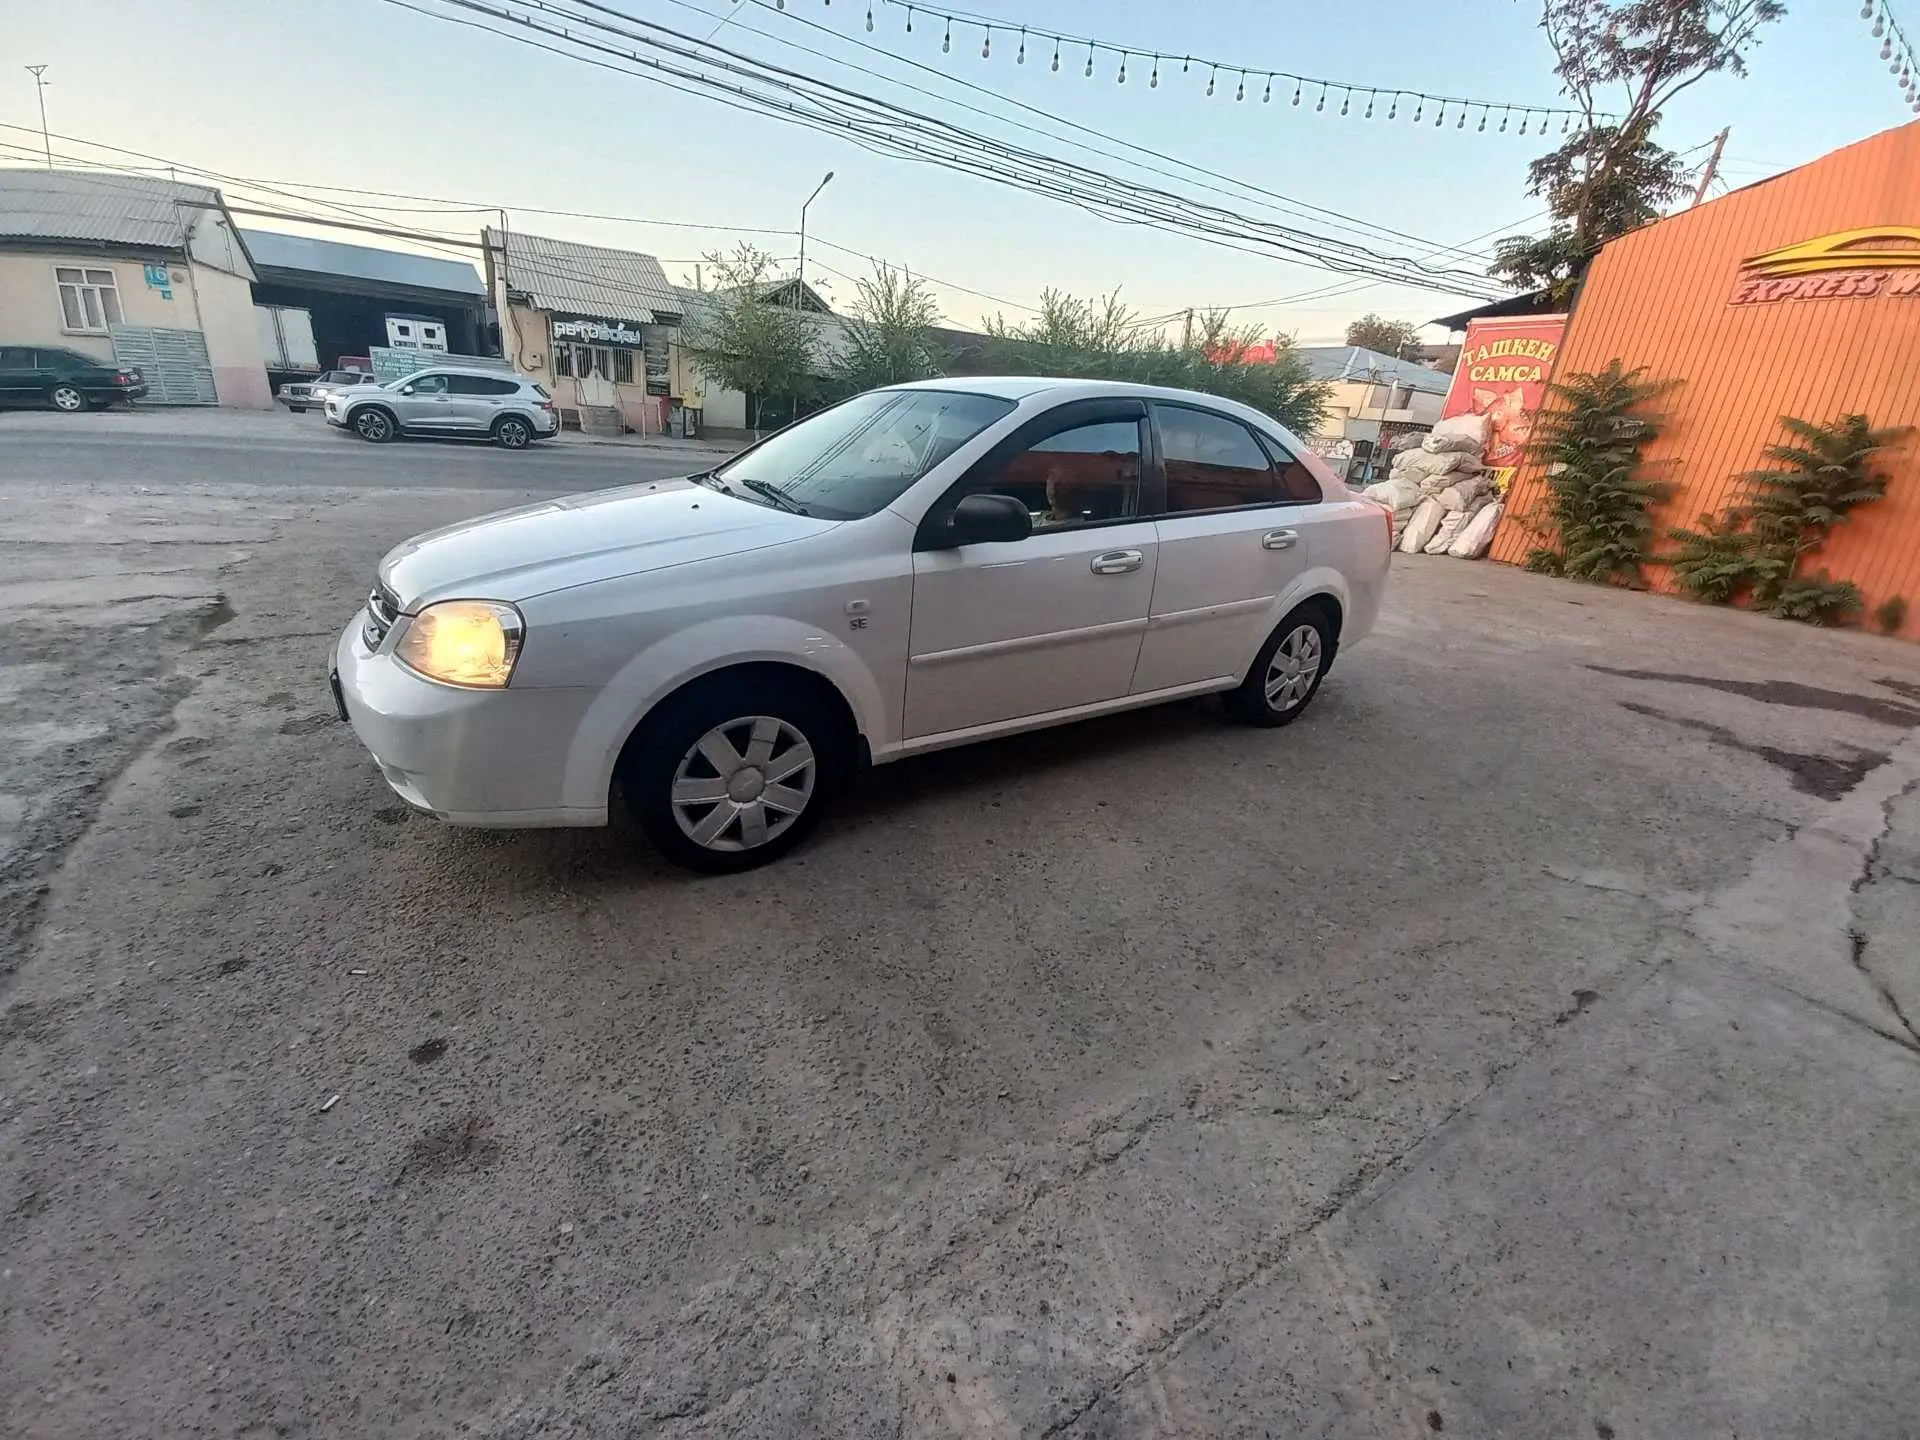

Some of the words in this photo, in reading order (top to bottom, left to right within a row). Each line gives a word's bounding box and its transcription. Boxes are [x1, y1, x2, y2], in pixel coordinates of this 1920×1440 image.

[146, 265, 168, 281] 16
[1728, 272, 1888, 304] EXPRESS
[1470, 365, 1542, 382] САМСА
[849, 617, 868, 631] SE
